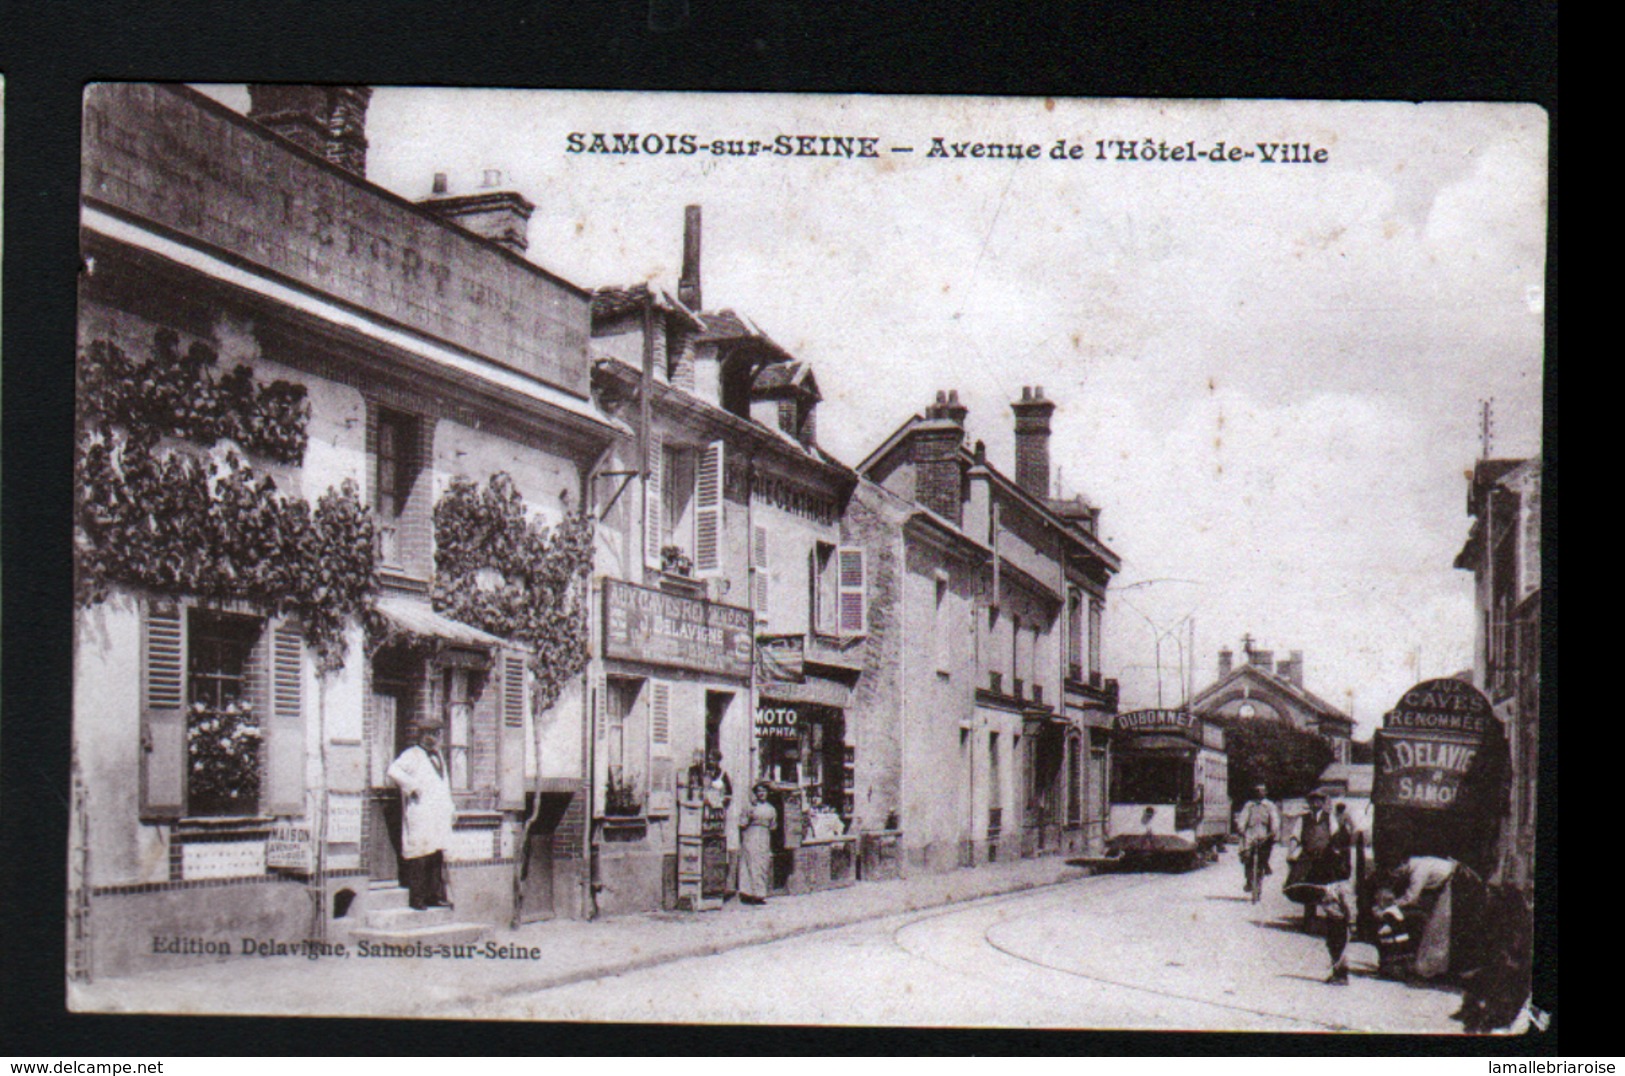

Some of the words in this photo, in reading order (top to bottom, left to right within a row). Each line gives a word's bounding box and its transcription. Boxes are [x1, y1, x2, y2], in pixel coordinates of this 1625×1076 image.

[654, 615, 724, 645] DELAVIGNE
[1405, 691, 1483, 712] CAVES
[754, 707, 798, 725] MOTO
[1118, 710, 1197, 729] DUBONNET
[1389, 709, 1490, 732] RENOMMÉE
[270, 827, 310, 843] MAISON
